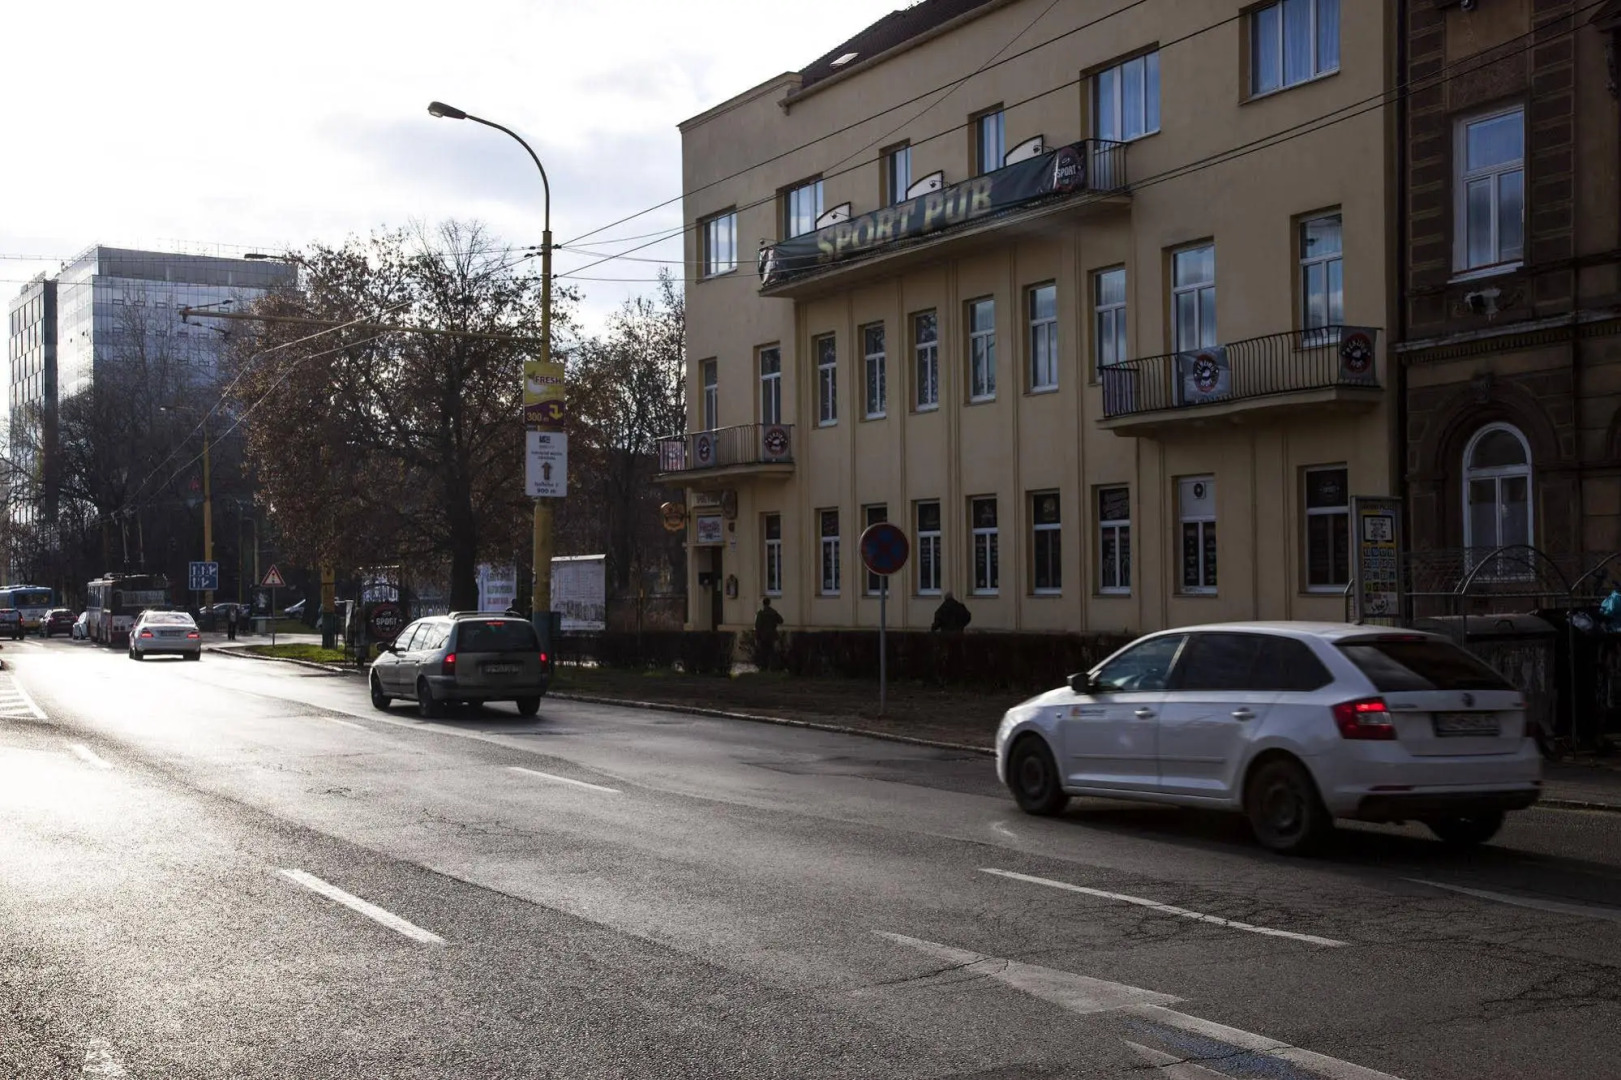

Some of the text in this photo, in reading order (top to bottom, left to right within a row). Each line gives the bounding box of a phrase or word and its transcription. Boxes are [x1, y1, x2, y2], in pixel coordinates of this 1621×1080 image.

[1056, 164, 1077, 178] SPORT
[817, 175, 993, 263] SPORT PUB
[535, 375, 562, 384] FRESH
[376, 617, 397, 625] SPORT
